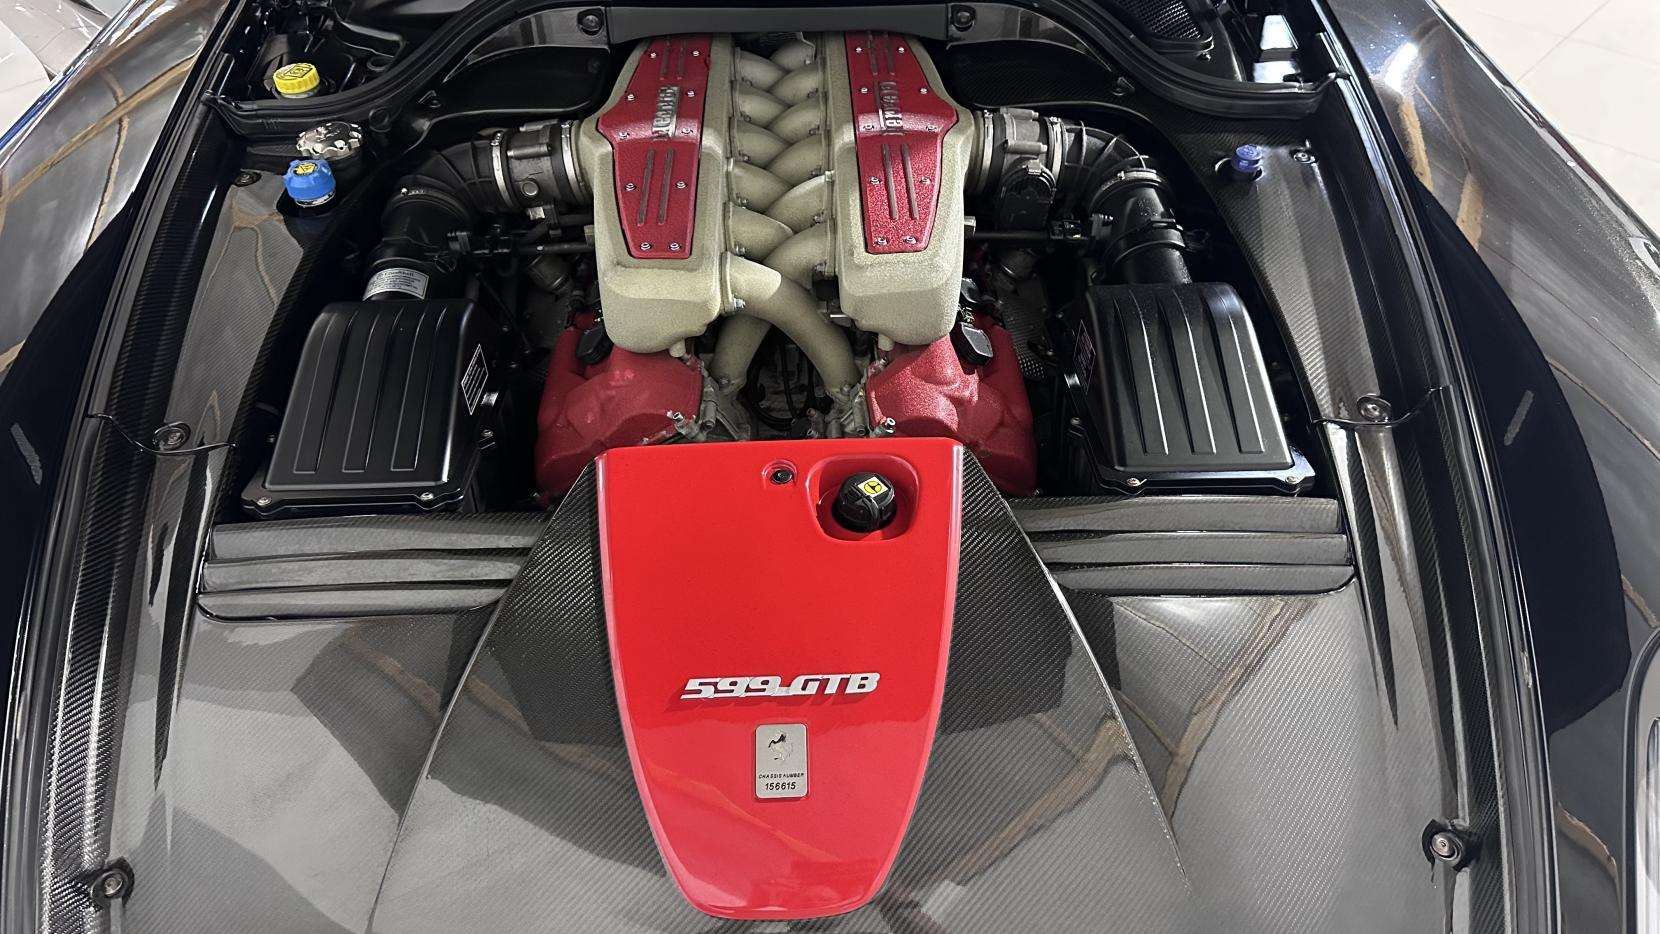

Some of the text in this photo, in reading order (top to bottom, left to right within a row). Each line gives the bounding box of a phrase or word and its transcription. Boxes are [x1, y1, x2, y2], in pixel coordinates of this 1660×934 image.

[681, 672, 880, 699] 599 GTB
[765, 782, 796, 790] 156615
